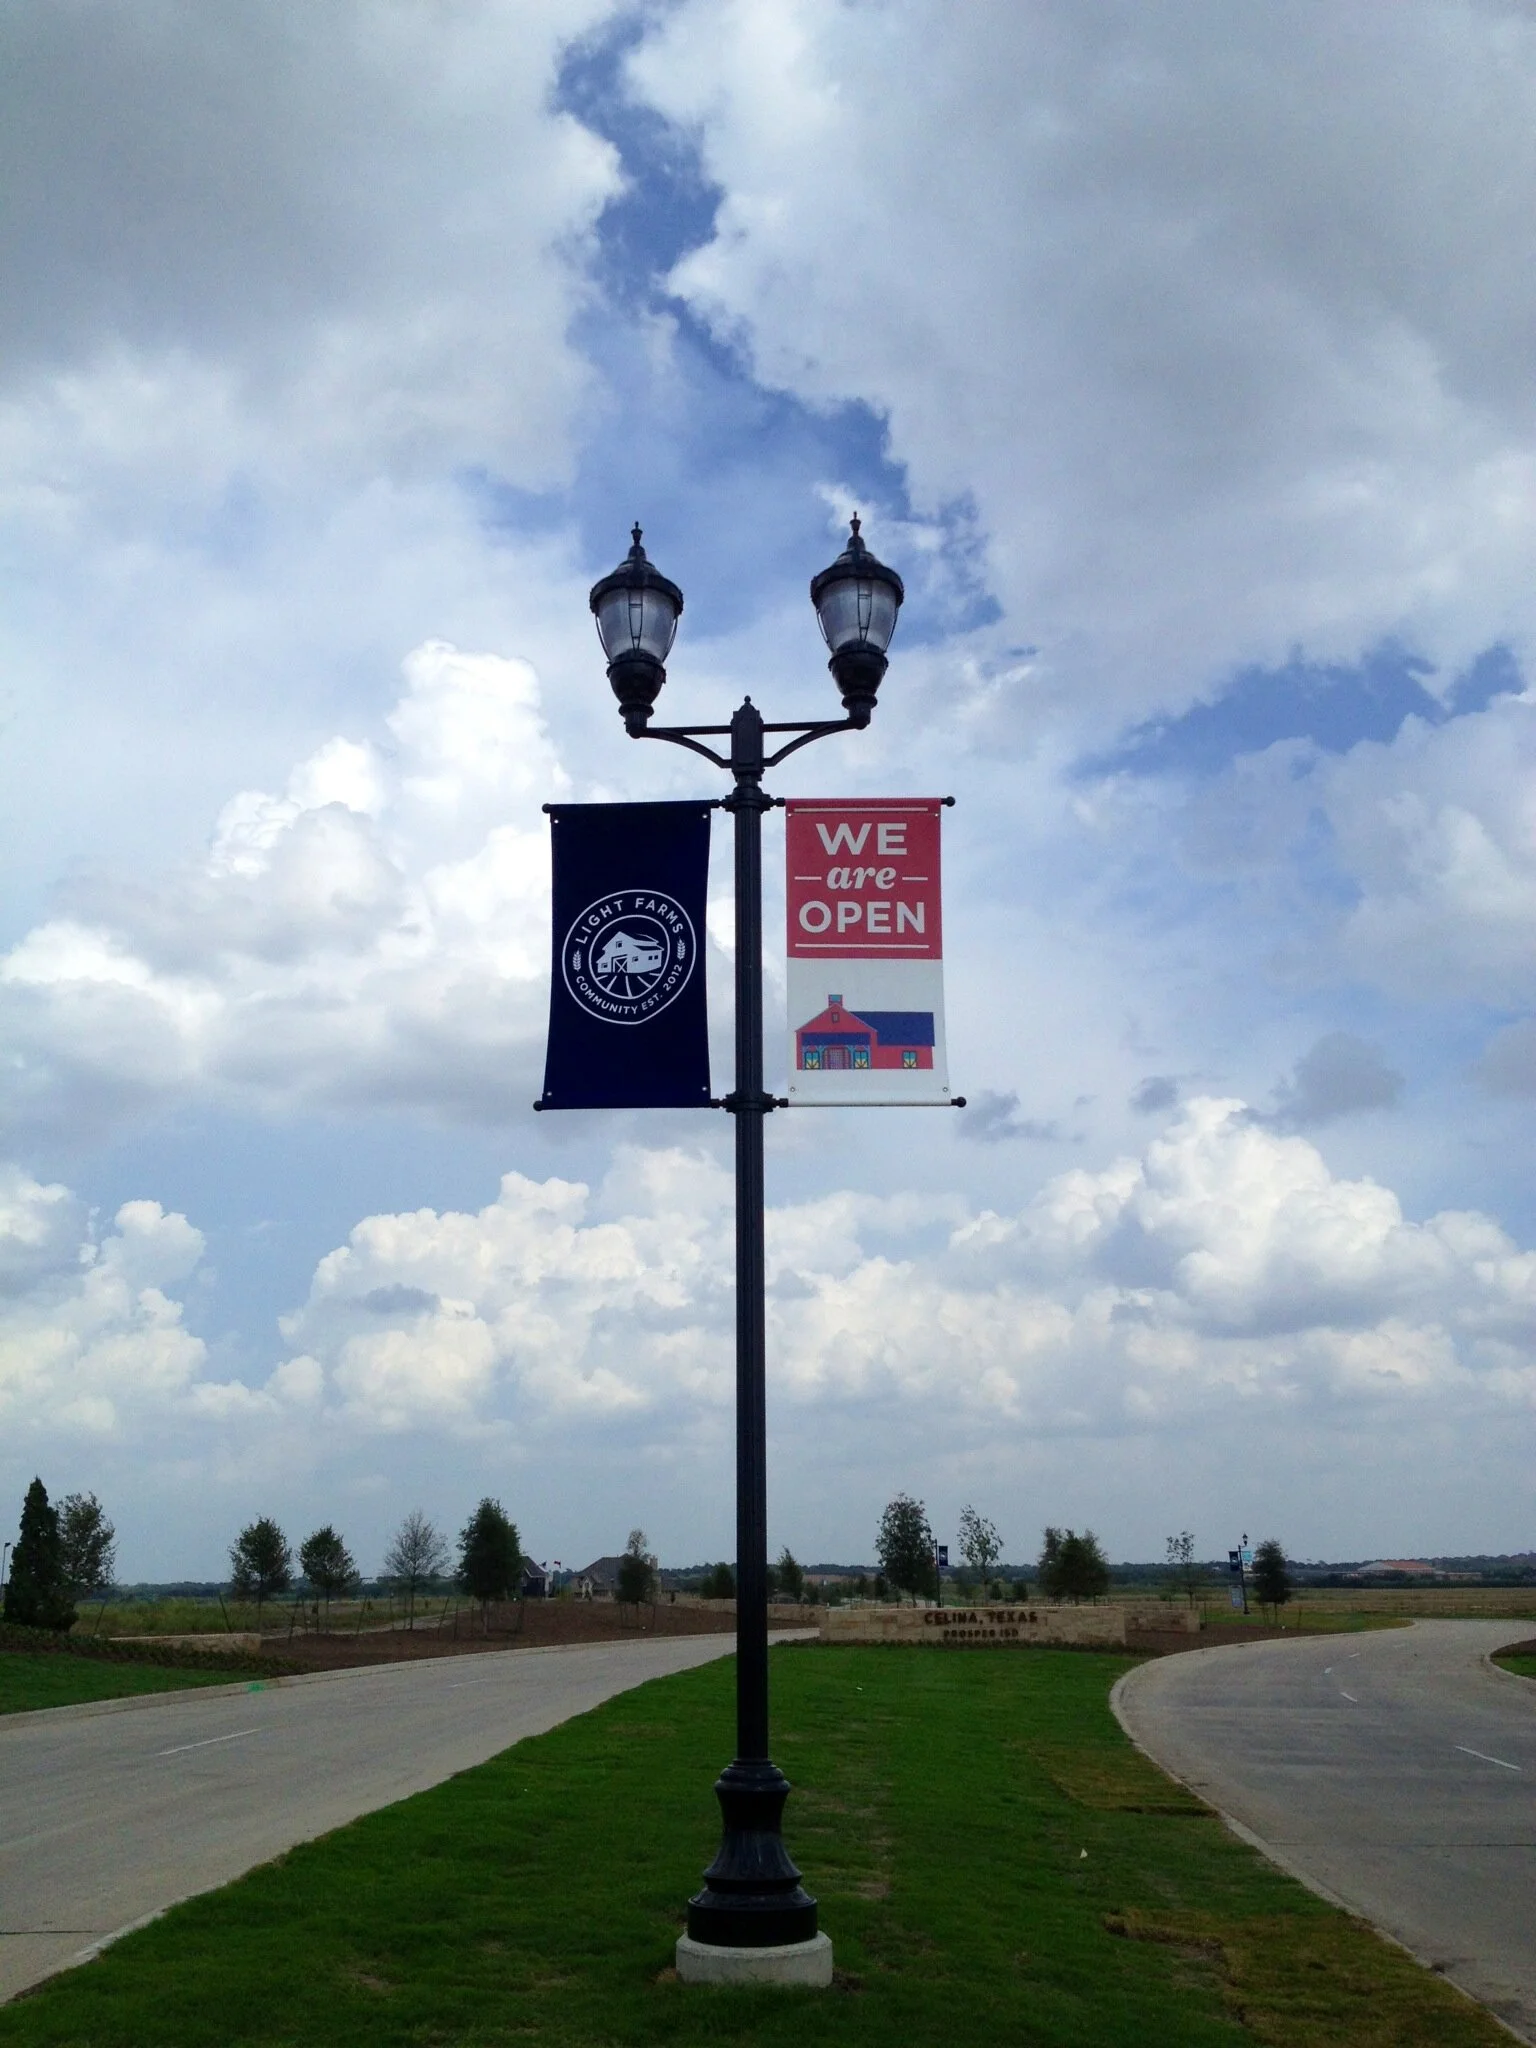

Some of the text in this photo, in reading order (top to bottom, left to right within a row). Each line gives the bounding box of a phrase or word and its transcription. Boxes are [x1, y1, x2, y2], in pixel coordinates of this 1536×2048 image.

[816, 823, 907, 855] WE
[826, 866, 897, 890] are
[575, 898, 684, 944] LIGHT FARMS
[799, 900, 925, 933] OPEN
[576, 964, 683, 1015] COMMUNITY EST. 2012
[924, 1611, 1038, 1625] CELINA, TEXAS
